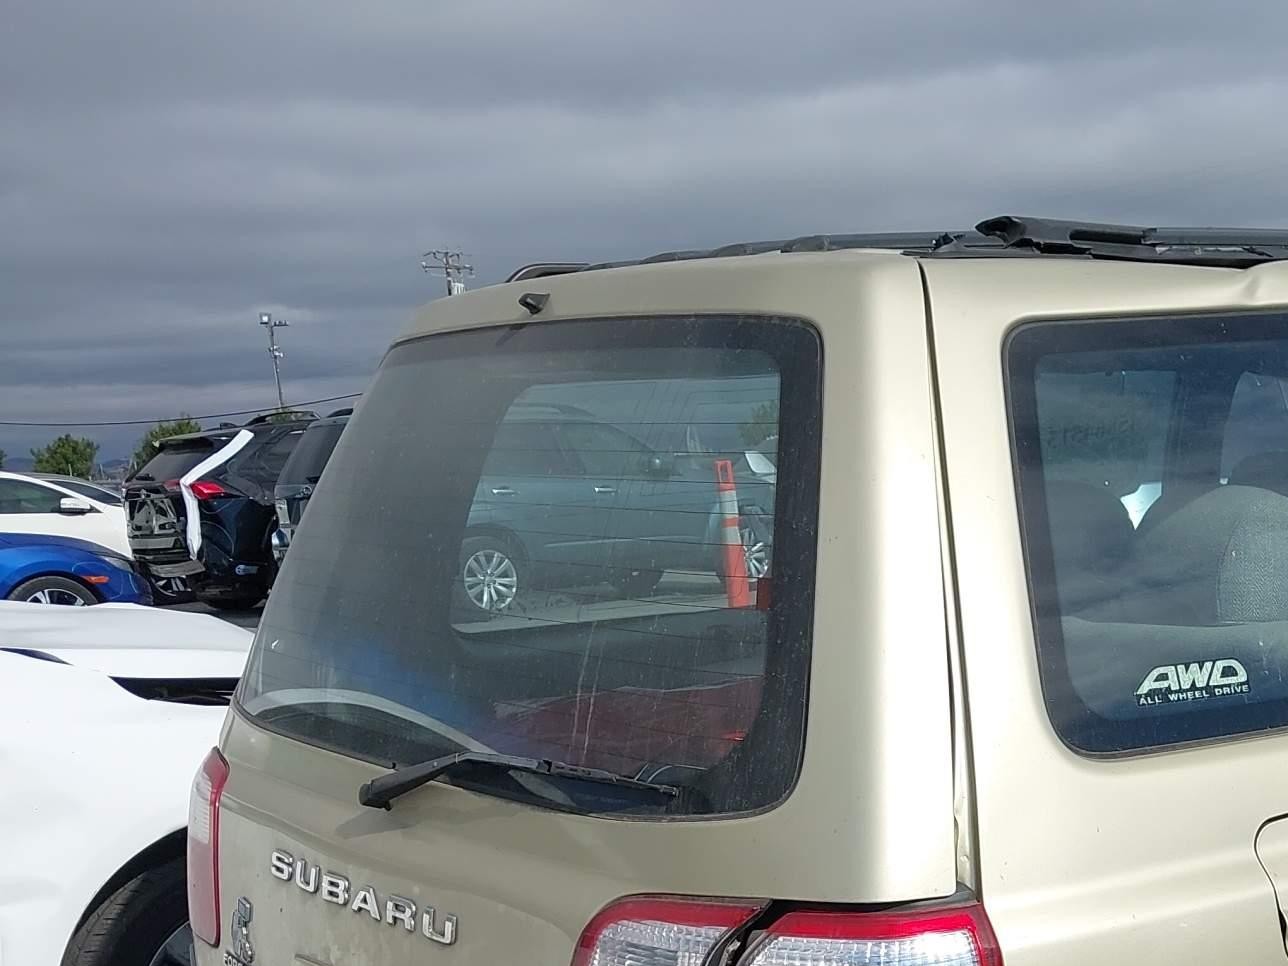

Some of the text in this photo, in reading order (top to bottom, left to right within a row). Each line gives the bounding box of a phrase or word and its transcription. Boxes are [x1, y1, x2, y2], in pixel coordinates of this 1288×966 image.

[1133, 658, 1248, 696] AWD
[1139, 684, 1249, 705] ALL WHEEL DRIVE
[270, 848, 458, 946] SUBARU
